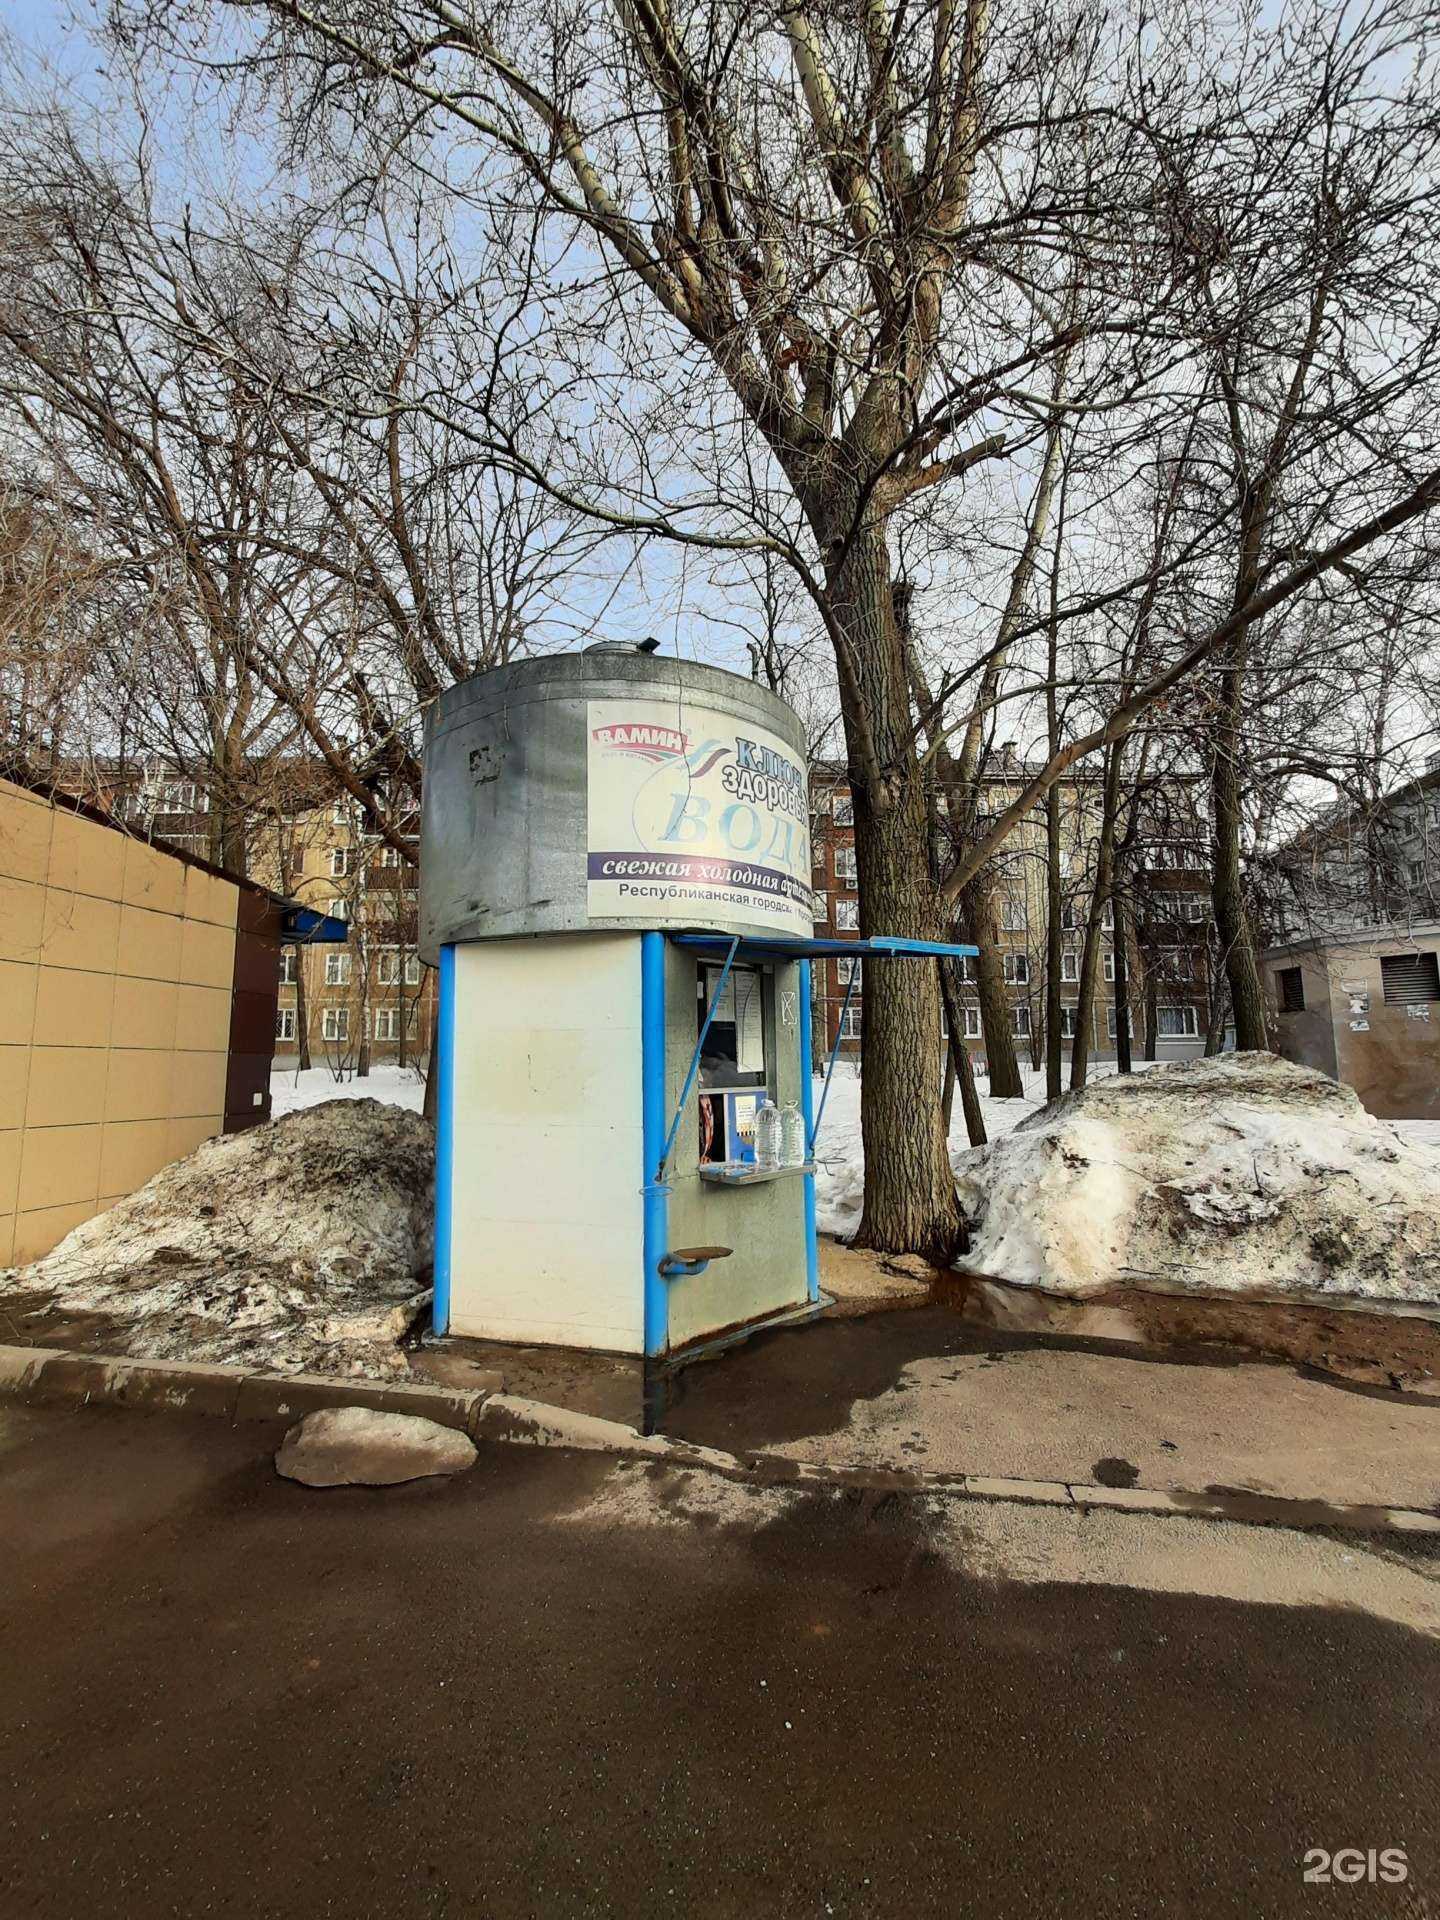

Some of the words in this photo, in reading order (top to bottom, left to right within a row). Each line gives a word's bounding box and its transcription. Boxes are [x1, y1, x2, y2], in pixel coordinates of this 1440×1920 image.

[597, 726, 683, 751] ВАМИН
[735, 736, 803, 799] КЛЮЧ
[657, 792, 808, 876] ВОДА
[602, 859, 691, 877] свежая
[696, 864, 779, 891] холодная
[618, 883, 750, 905] Республиканская
